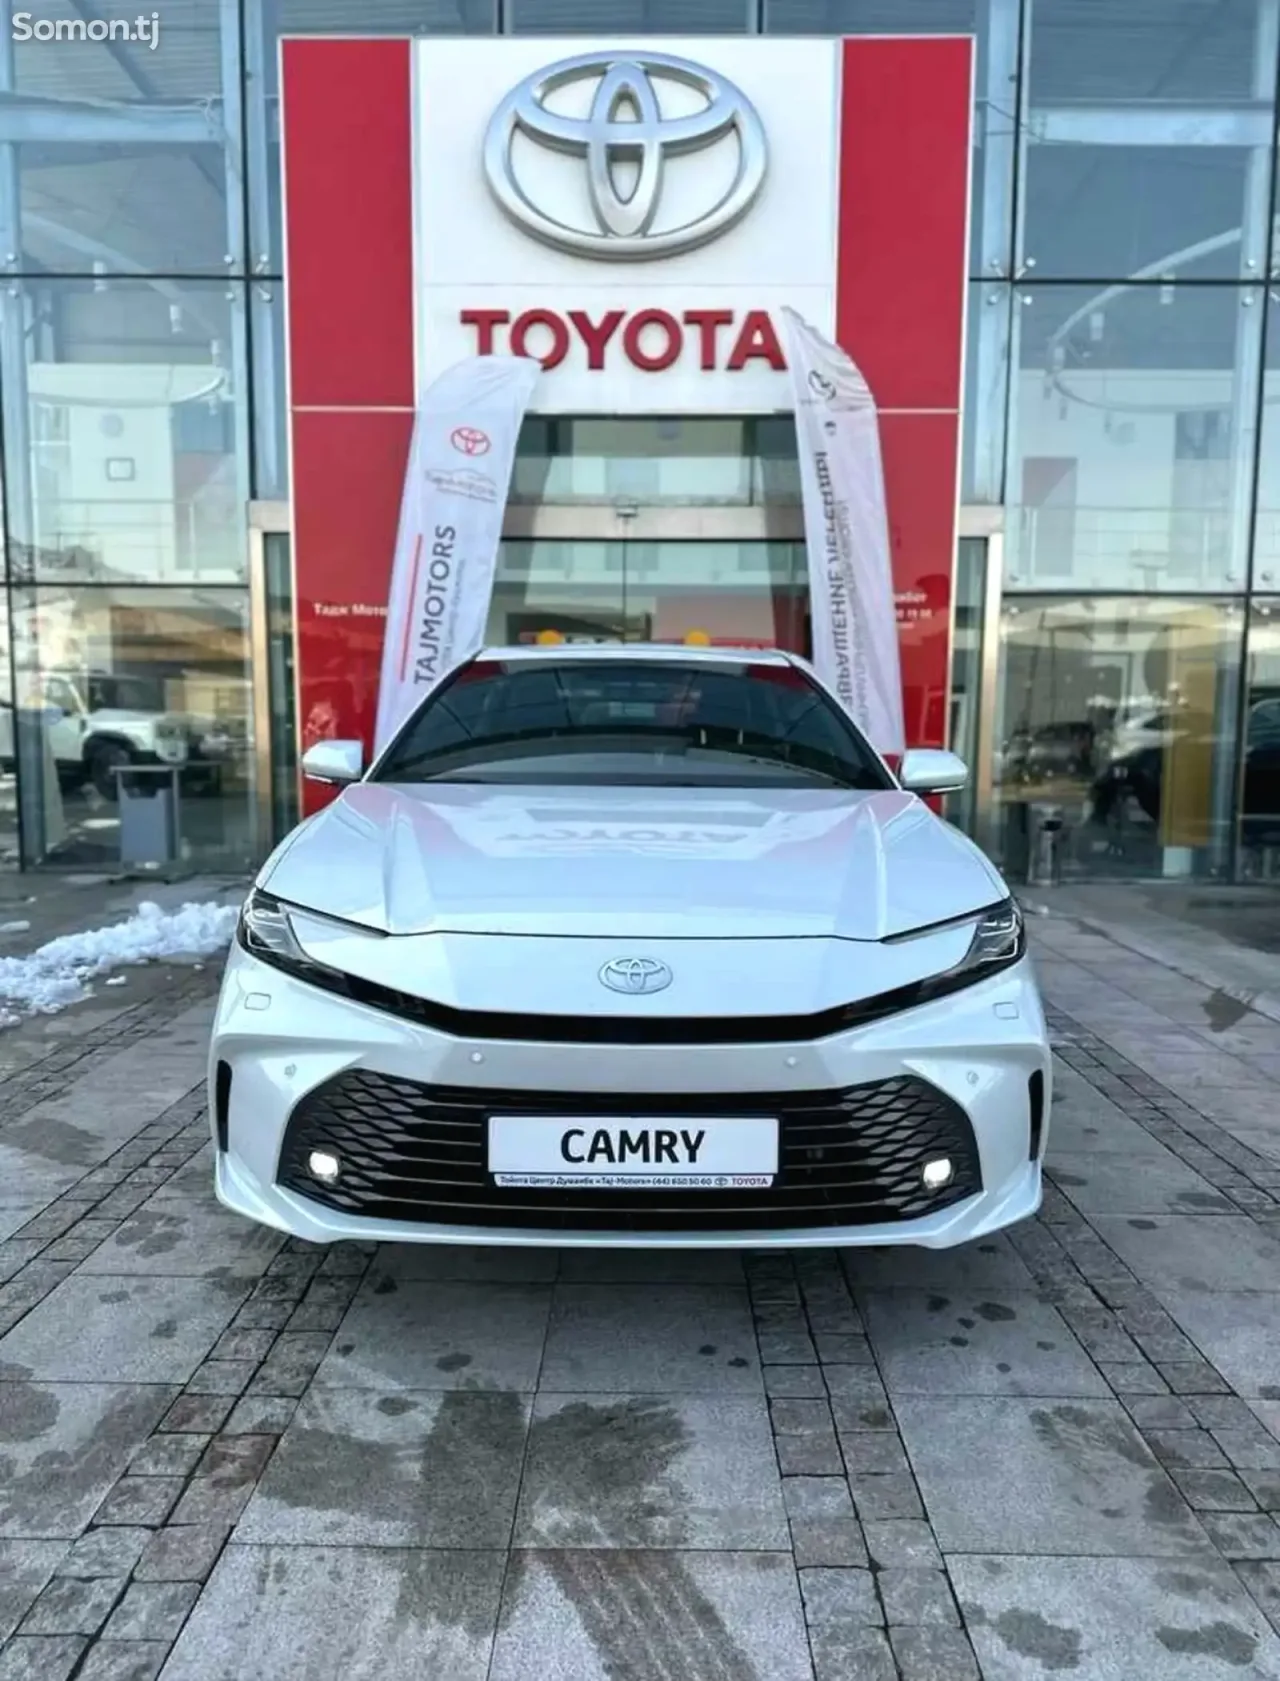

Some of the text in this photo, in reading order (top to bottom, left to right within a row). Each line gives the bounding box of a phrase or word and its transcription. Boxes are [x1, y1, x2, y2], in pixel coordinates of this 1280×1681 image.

[460, 308, 788, 372] TOYOTA
[414, 524, 456, 685] TAJMOTORS
[561, 1129, 706, 1164] CAMRY
[732, 1177, 768, 1186] TOYOTA
